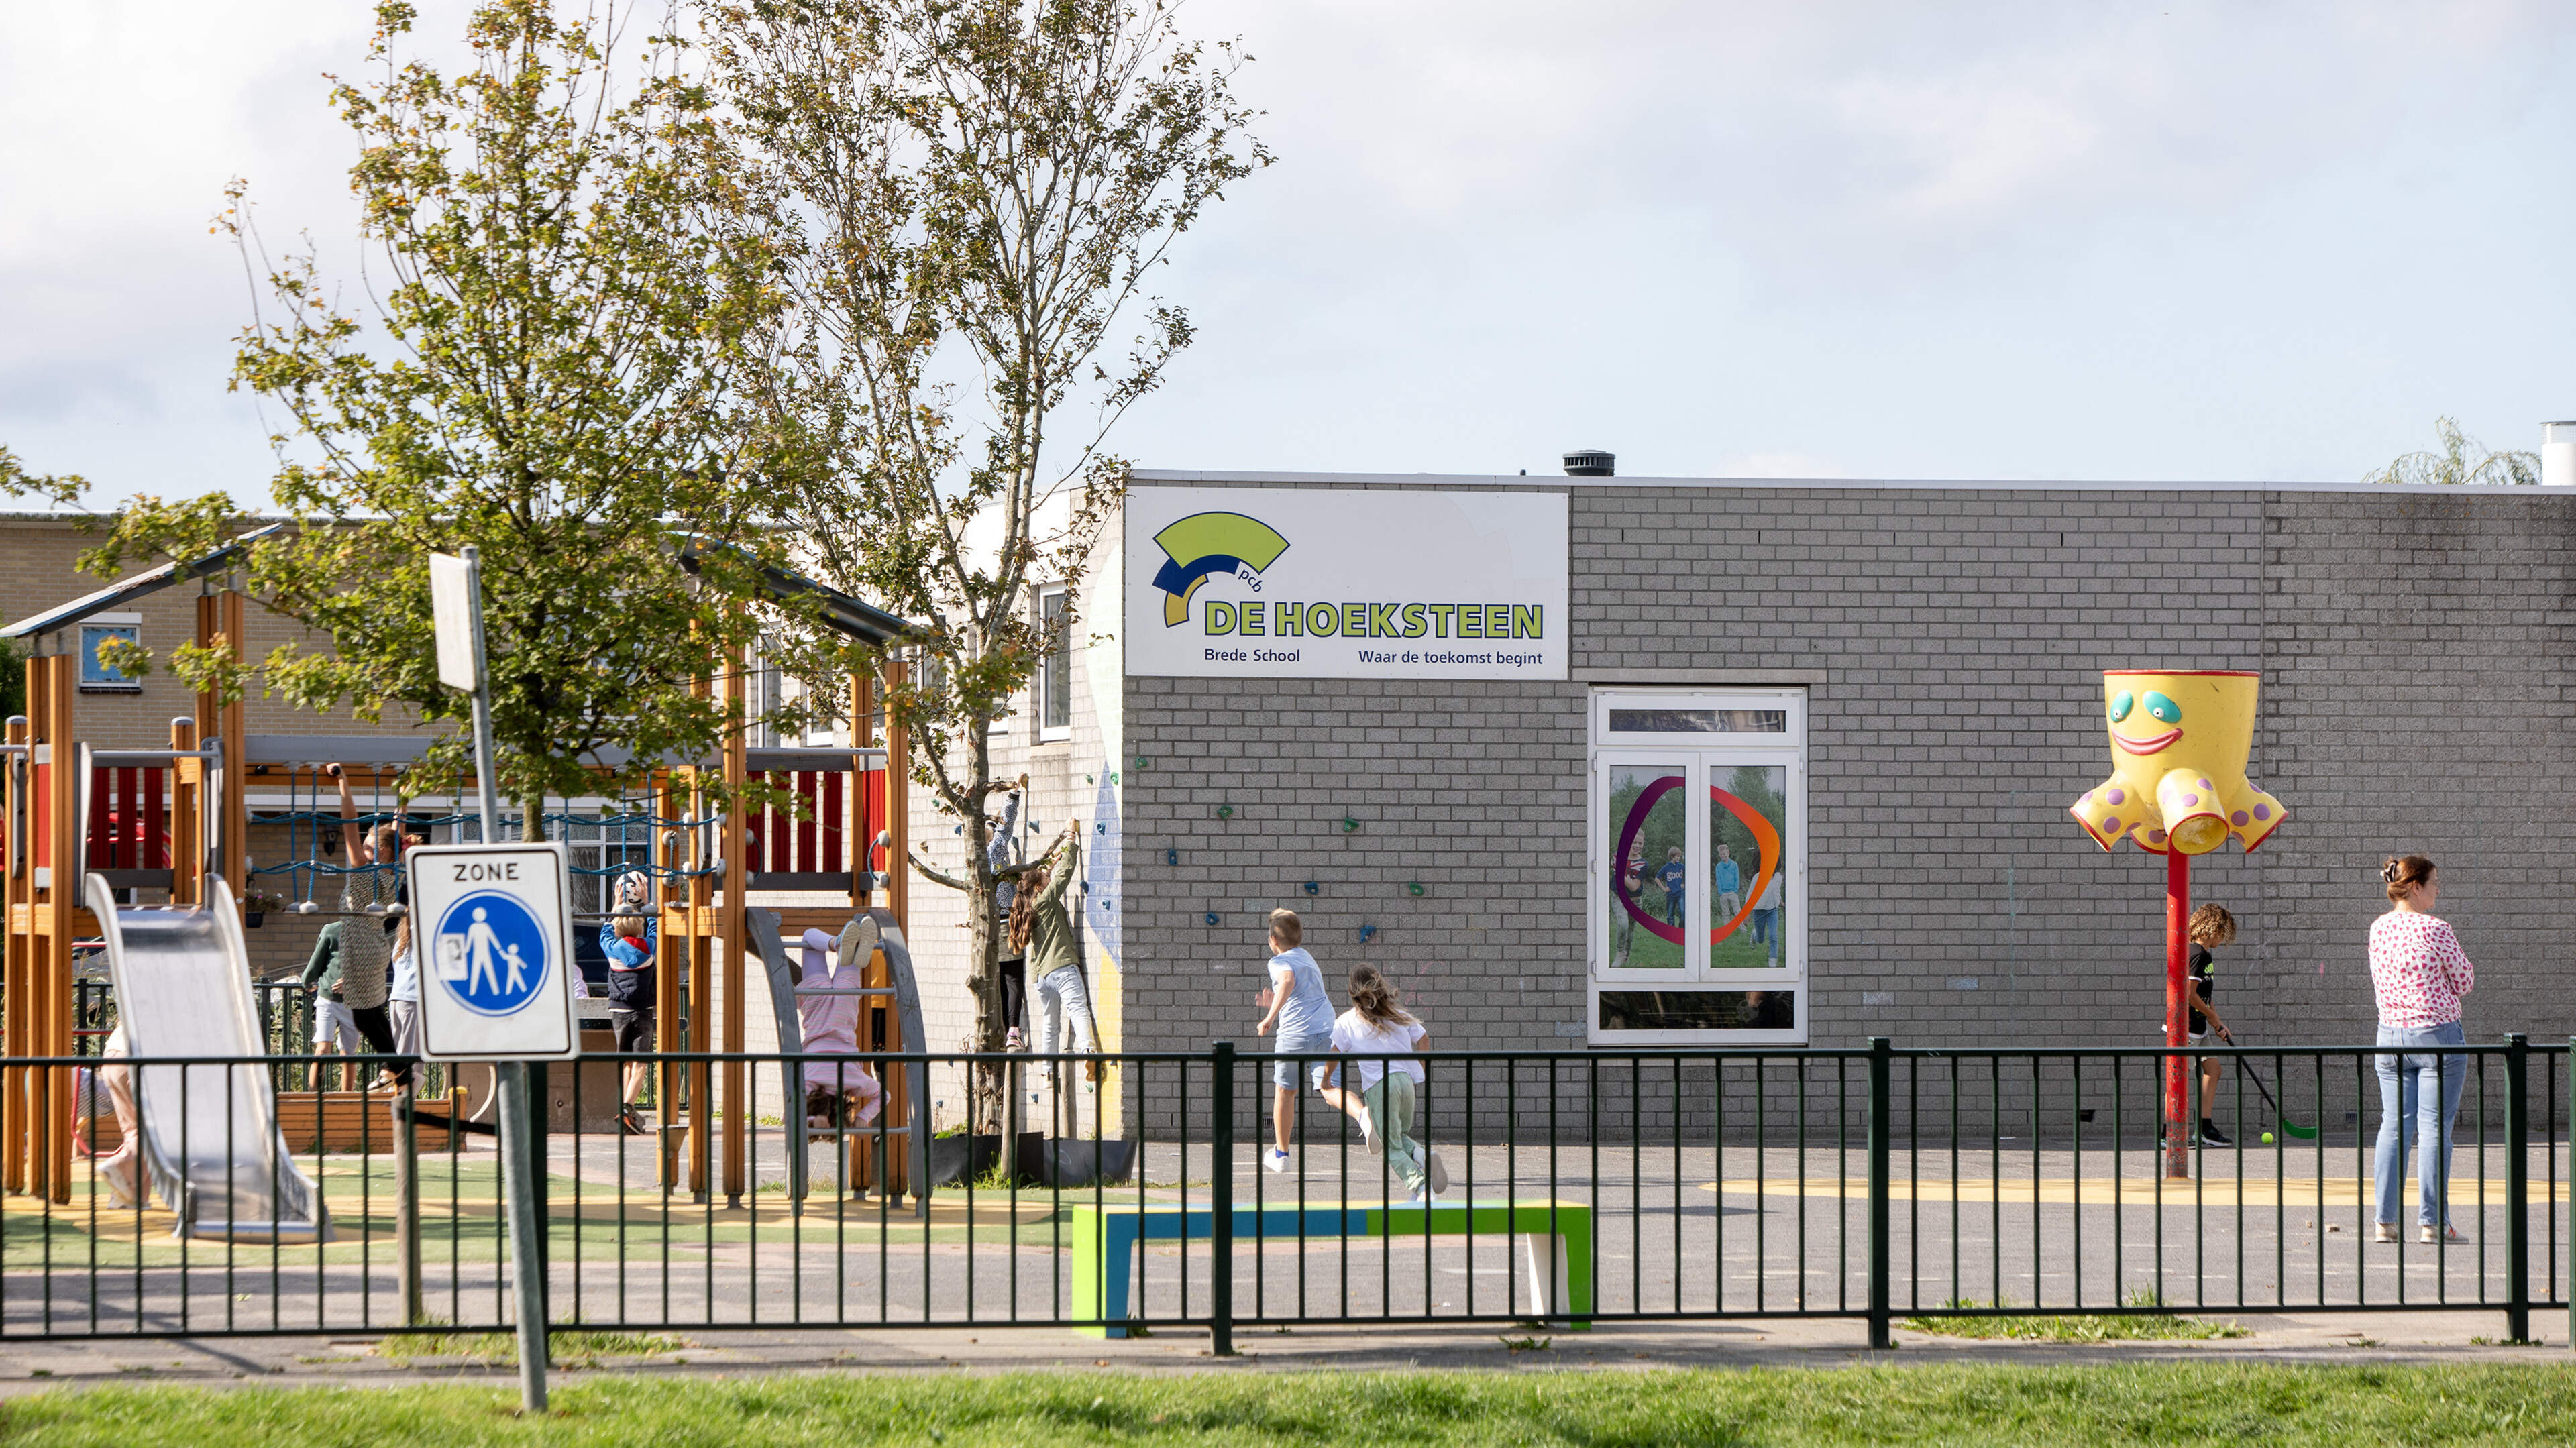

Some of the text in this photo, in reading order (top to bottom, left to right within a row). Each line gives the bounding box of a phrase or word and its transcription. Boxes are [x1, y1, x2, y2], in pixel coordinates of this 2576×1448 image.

[1238, 569, 1263, 592] pcb
[1205, 601, 1544, 639] DE HOEKSTEEN
[1204, 649, 1300, 662] Brede School
[1358, 650, 1544, 667] Waar de toekomst begint
[453, 862, 519, 882] ZONE
[1666, 869, 1683, 881] good
